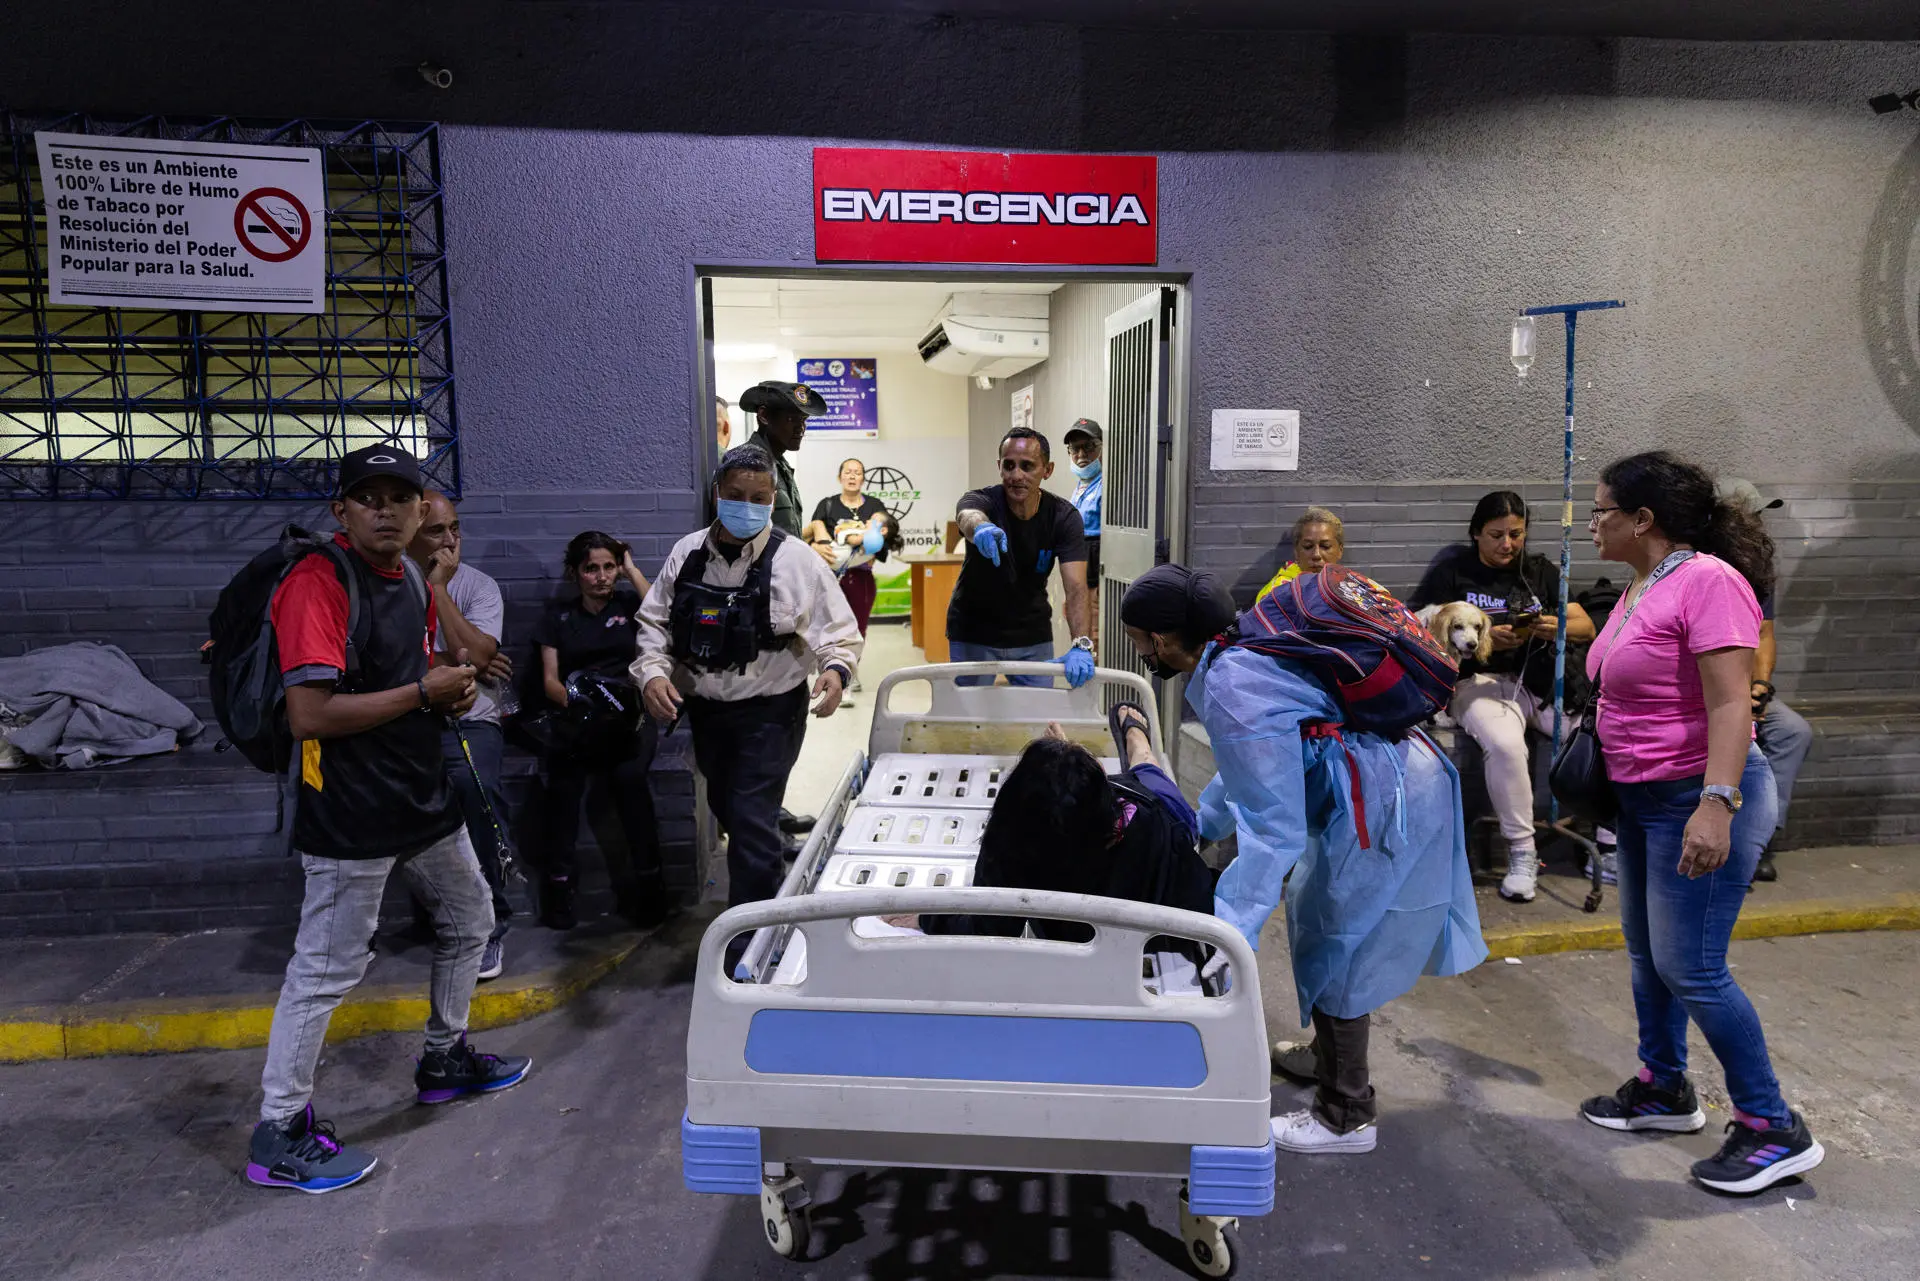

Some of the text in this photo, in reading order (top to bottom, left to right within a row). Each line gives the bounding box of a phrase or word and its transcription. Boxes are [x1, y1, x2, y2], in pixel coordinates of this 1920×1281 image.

[51, 153, 238, 179] Este es un Ambiente
[55, 174, 239, 199] 100% Libre de Humo
[57, 195, 184, 218] de Tabaco por
[822, 188, 1149, 226] EMERGENCIA
[59, 215, 189, 236] Resolución del
[60, 235, 236, 258] Ministerio del Poder
[61, 255, 254, 278] Popular para la Salud.
